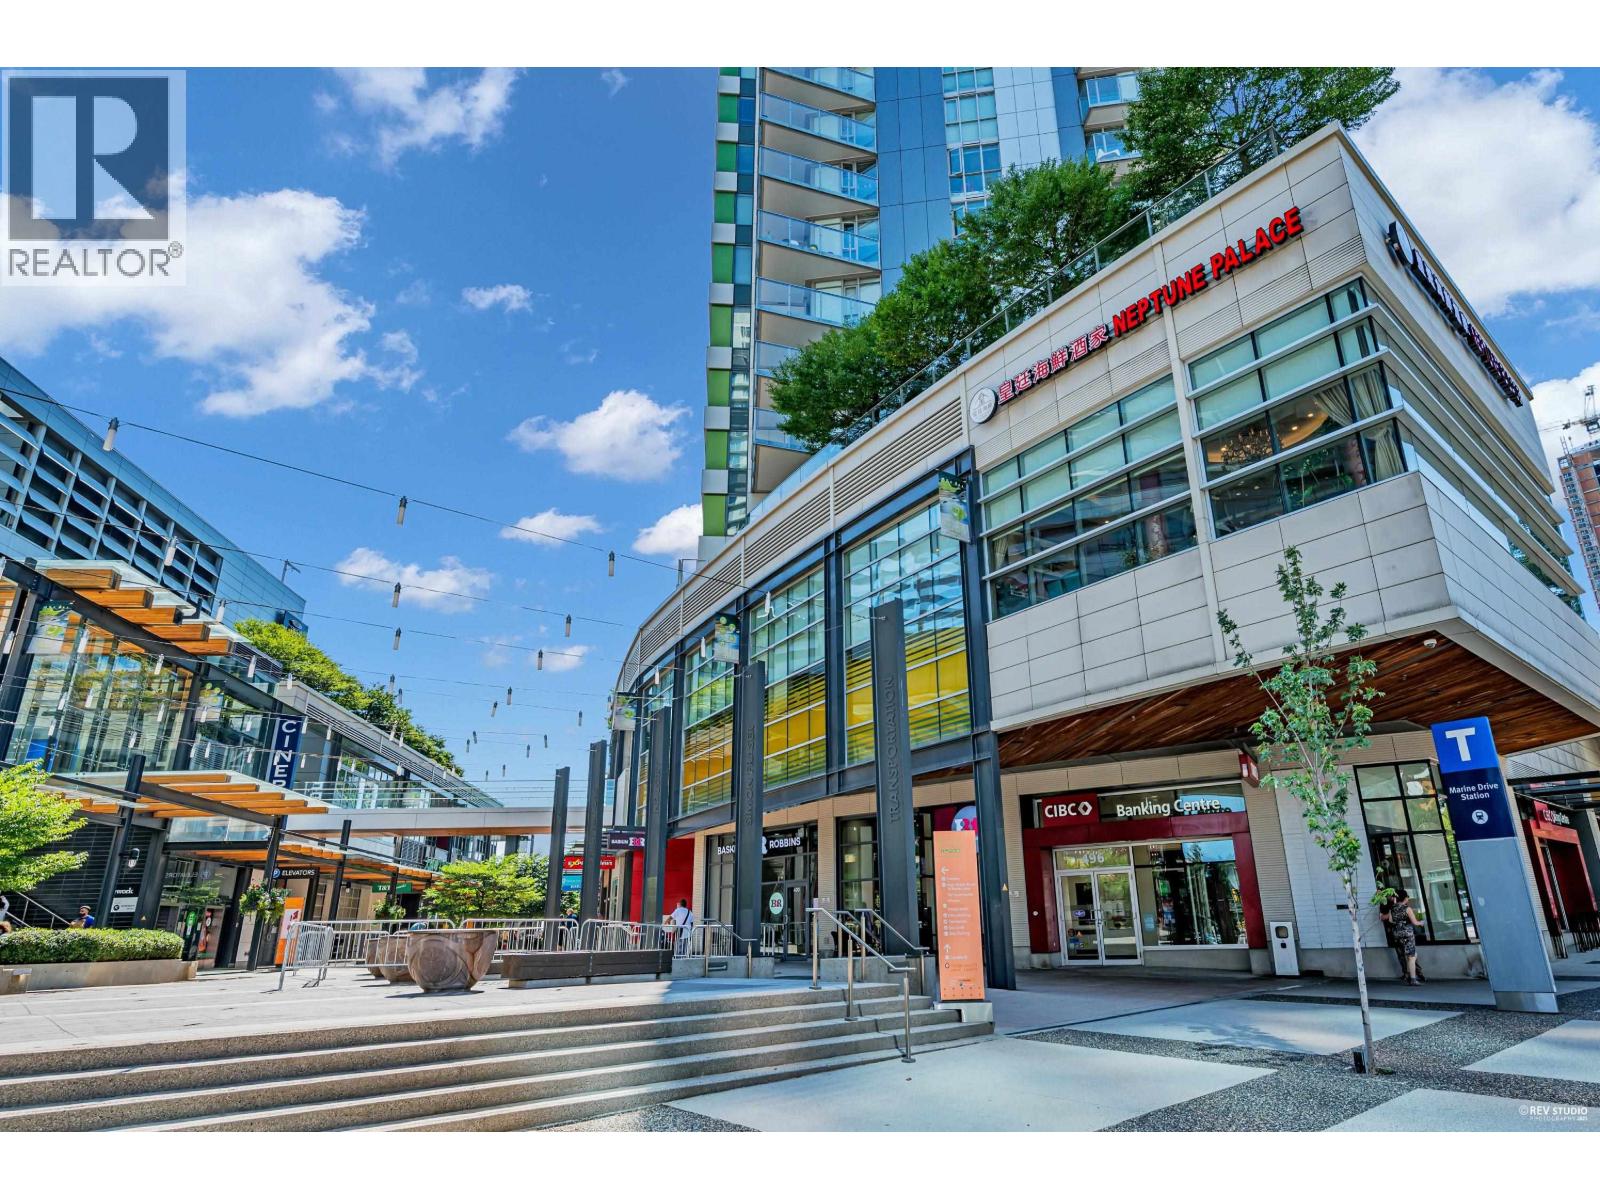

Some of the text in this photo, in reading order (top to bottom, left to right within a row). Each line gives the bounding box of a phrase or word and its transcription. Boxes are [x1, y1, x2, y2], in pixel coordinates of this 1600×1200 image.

[1112, 206, 1304, 338] NEPTUNE PALACE
[998, 323, 1109, 404] 皇廷海鮮酒家
[884, 674, 901, 824] TRANSPORTATION
[1445, 727, 1476, 762] T
[1449, 782, 1499, 794] Marine Drive
[1460, 791, 1490, 801] Station
[1044, 803, 1077, 818] CIBC
[1116, 798, 1221, 817] Banking Centre
[717, 844, 736, 855] BASK
[769, 836, 801, 849] ROBBINS
